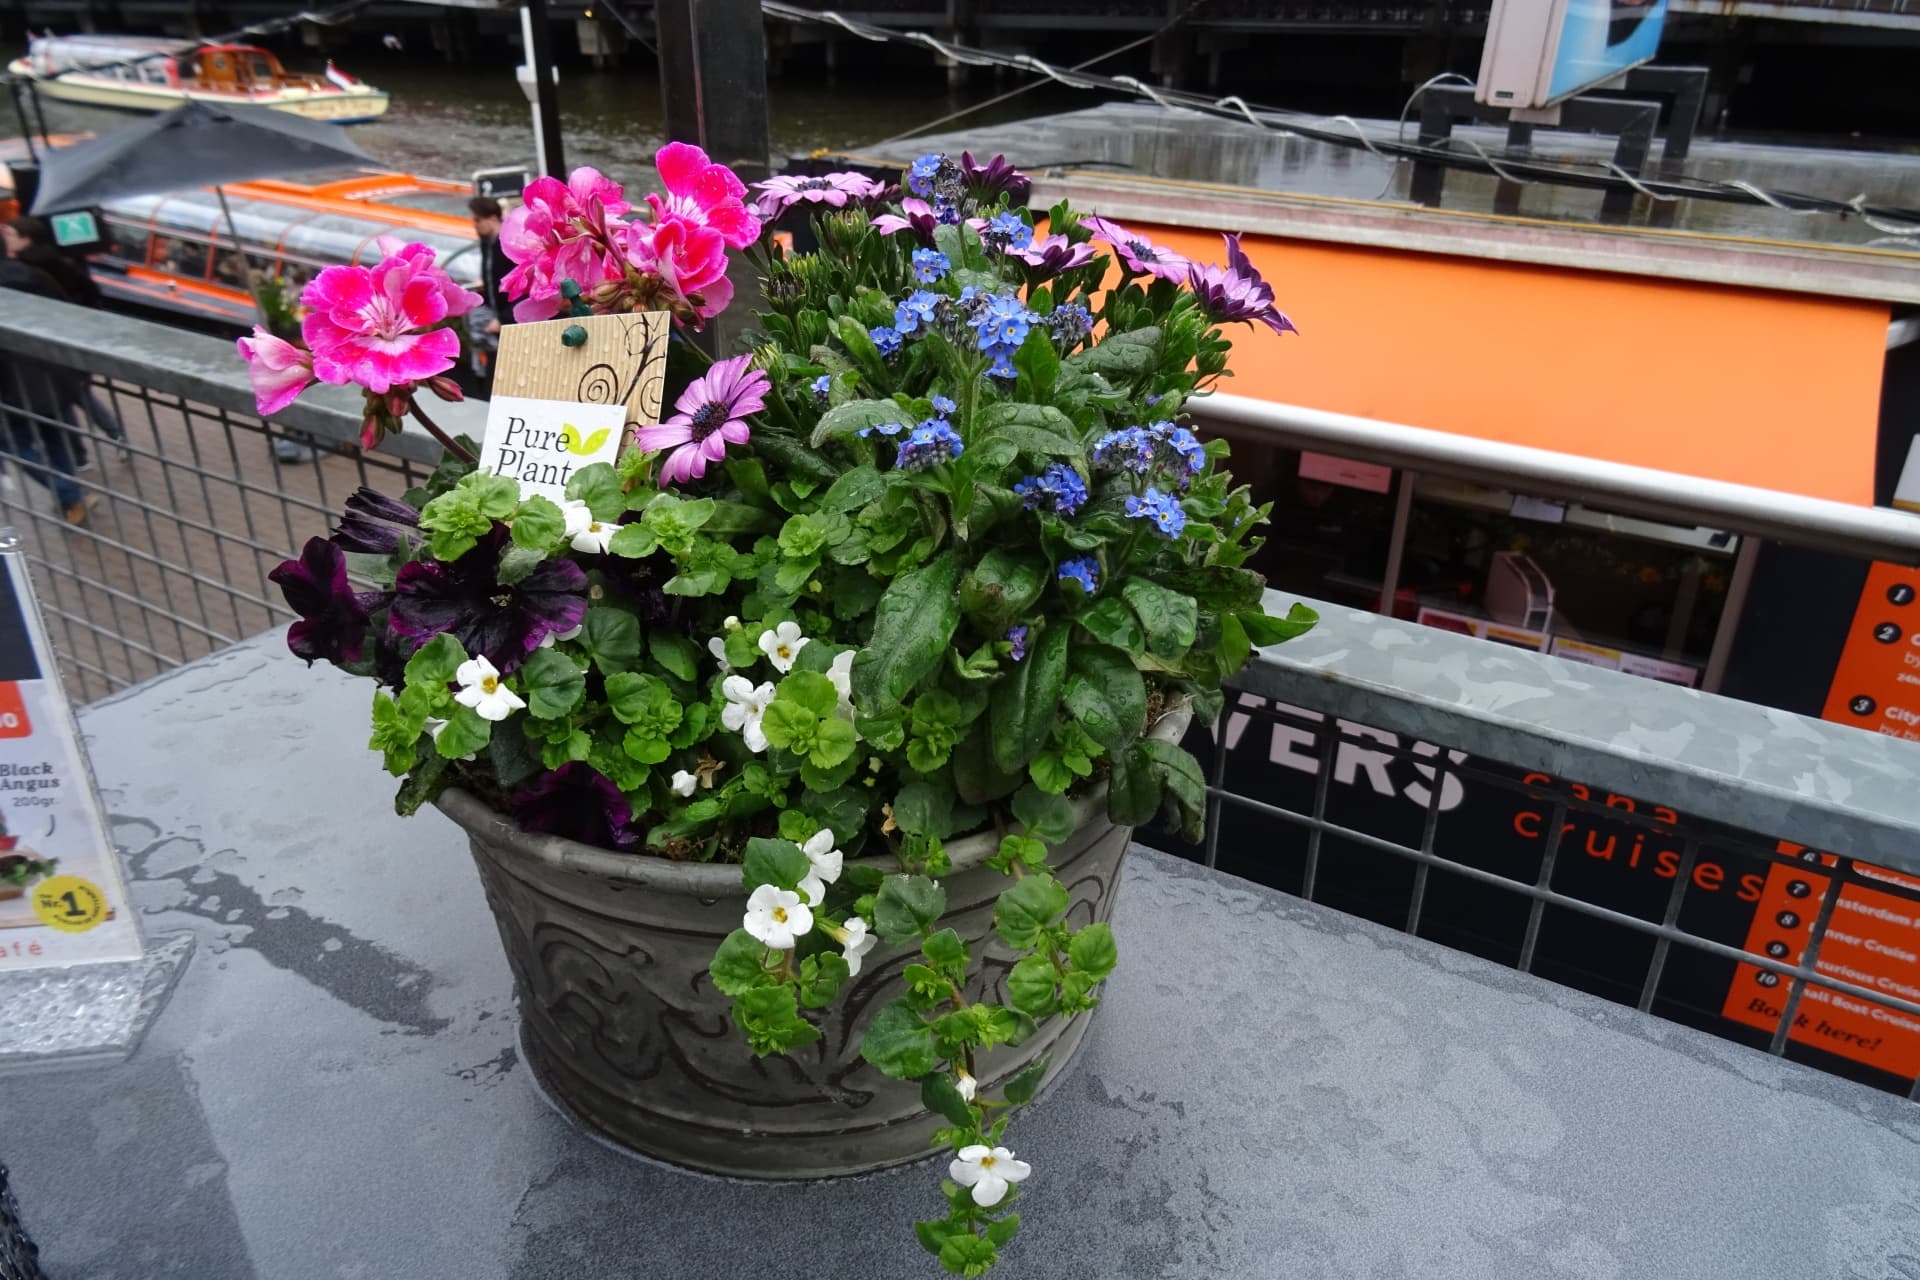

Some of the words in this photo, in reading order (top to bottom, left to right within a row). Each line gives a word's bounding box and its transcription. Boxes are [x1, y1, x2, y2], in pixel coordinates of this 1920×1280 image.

[502, 416, 571, 454] Pure
[494, 448, 573, 487] Plant
[1878, 626, 1893, 640] 2
[1854, 699, 1868, 712] 3
[0, 762, 53, 777] Black
[0, 778, 60, 792] Angus
[1513, 811, 1765, 902] cruises
[60, 891, 86, 917] 1
[1808, 922, 1862, 947] Dnner
[1864, 939, 1917, 964] Cruise
[1797, 952, 1875, 985] Lxurious
[1757, 971, 1777, 985] 10
[1832, 995, 1869, 1015] Boat
[1747, 998, 1809, 1029] Bok
[1815, 1019, 1883, 1052] here!
